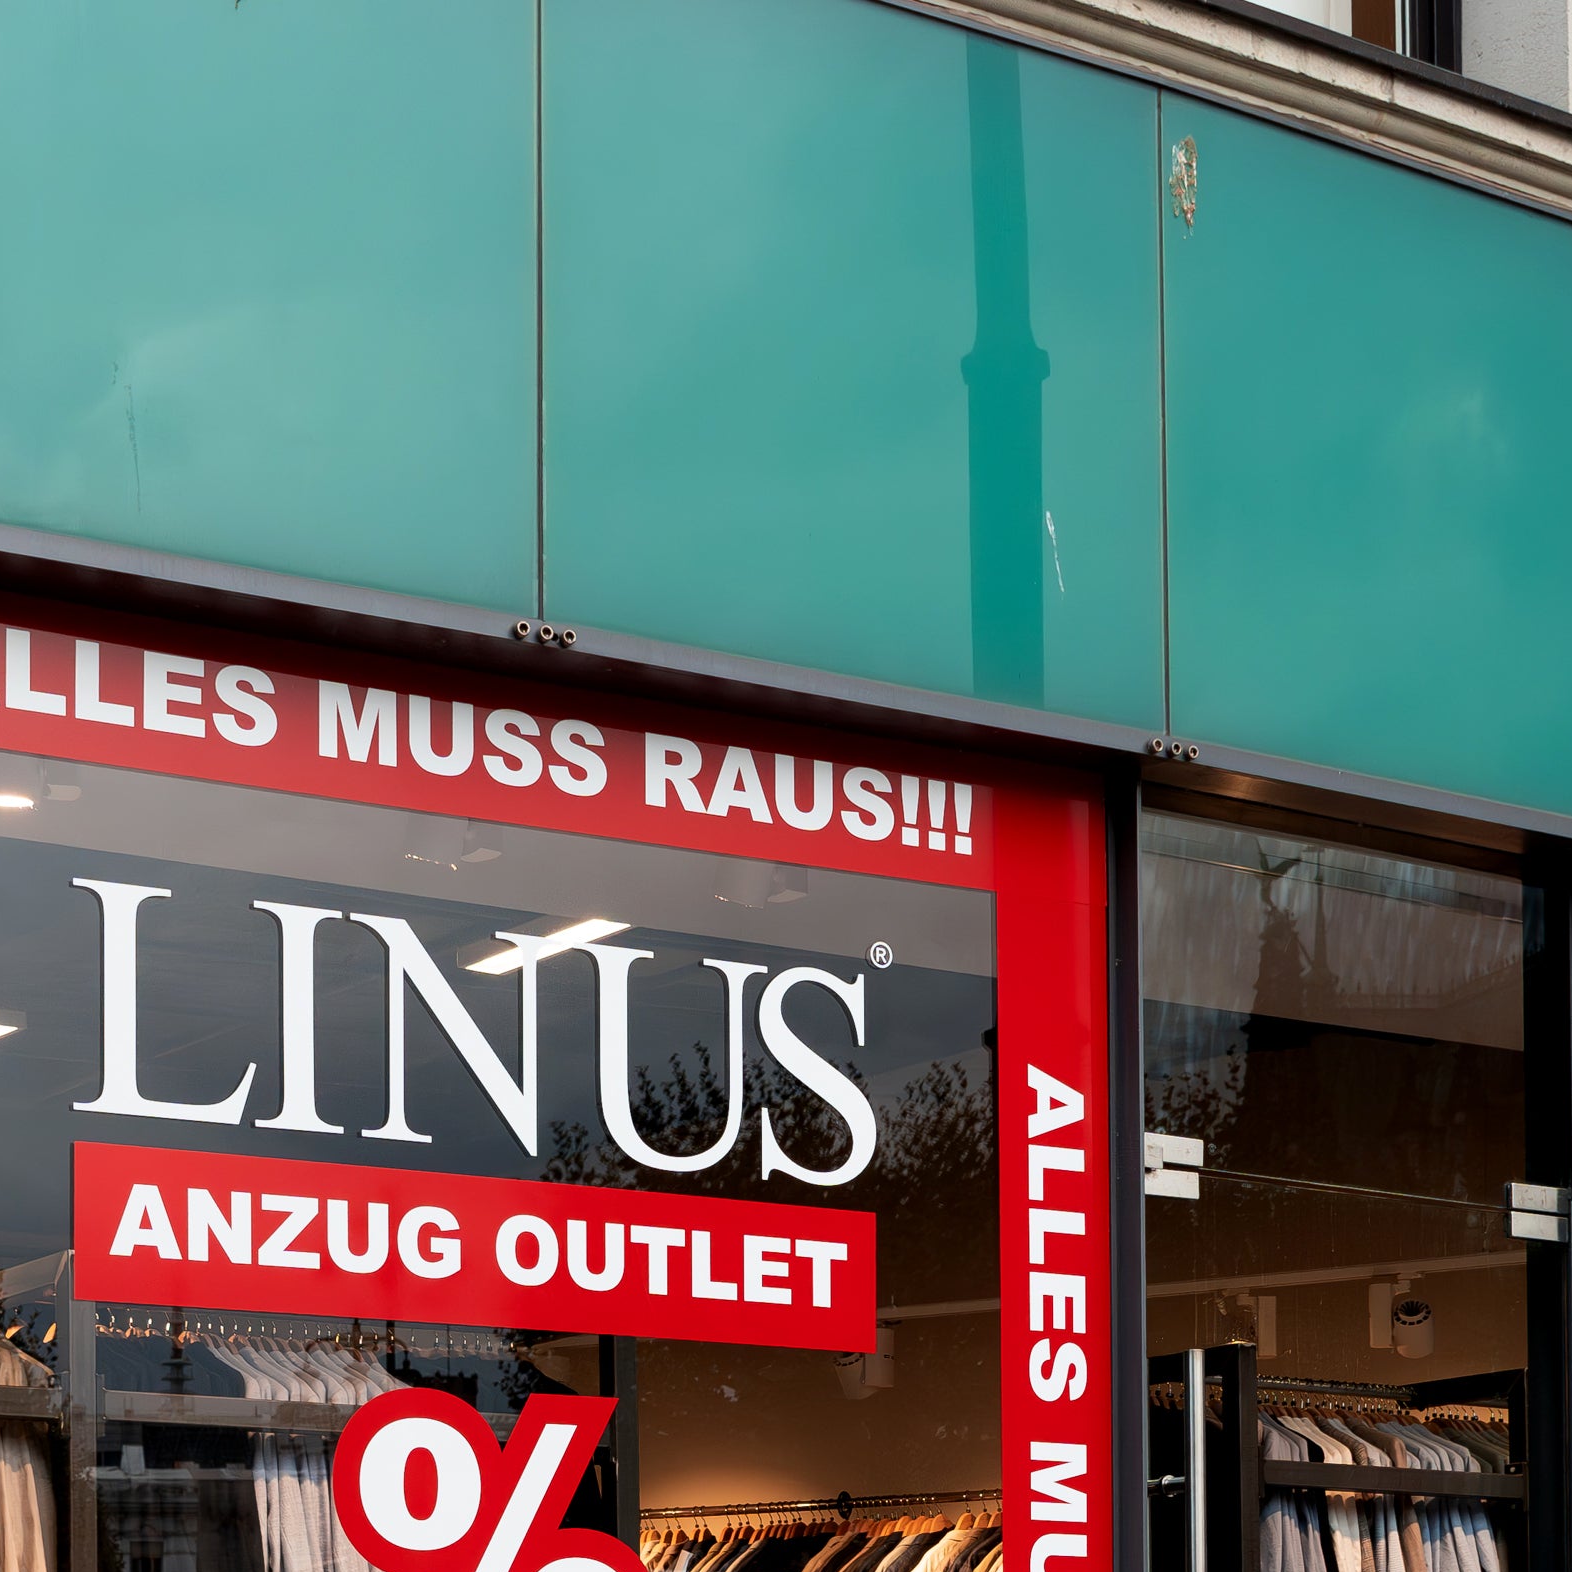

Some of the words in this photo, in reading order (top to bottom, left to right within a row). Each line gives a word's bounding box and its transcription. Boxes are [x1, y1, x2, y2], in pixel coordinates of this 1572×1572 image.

[319, 680, 608, 797] MUSS
[646, 733, 973, 856] RAUS!!!
[110, 1184, 462, 1279] ANZUG
[496, 1215, 848, 1308] OUTLET
[1028, 1064, 1088, 1402] ALLES
